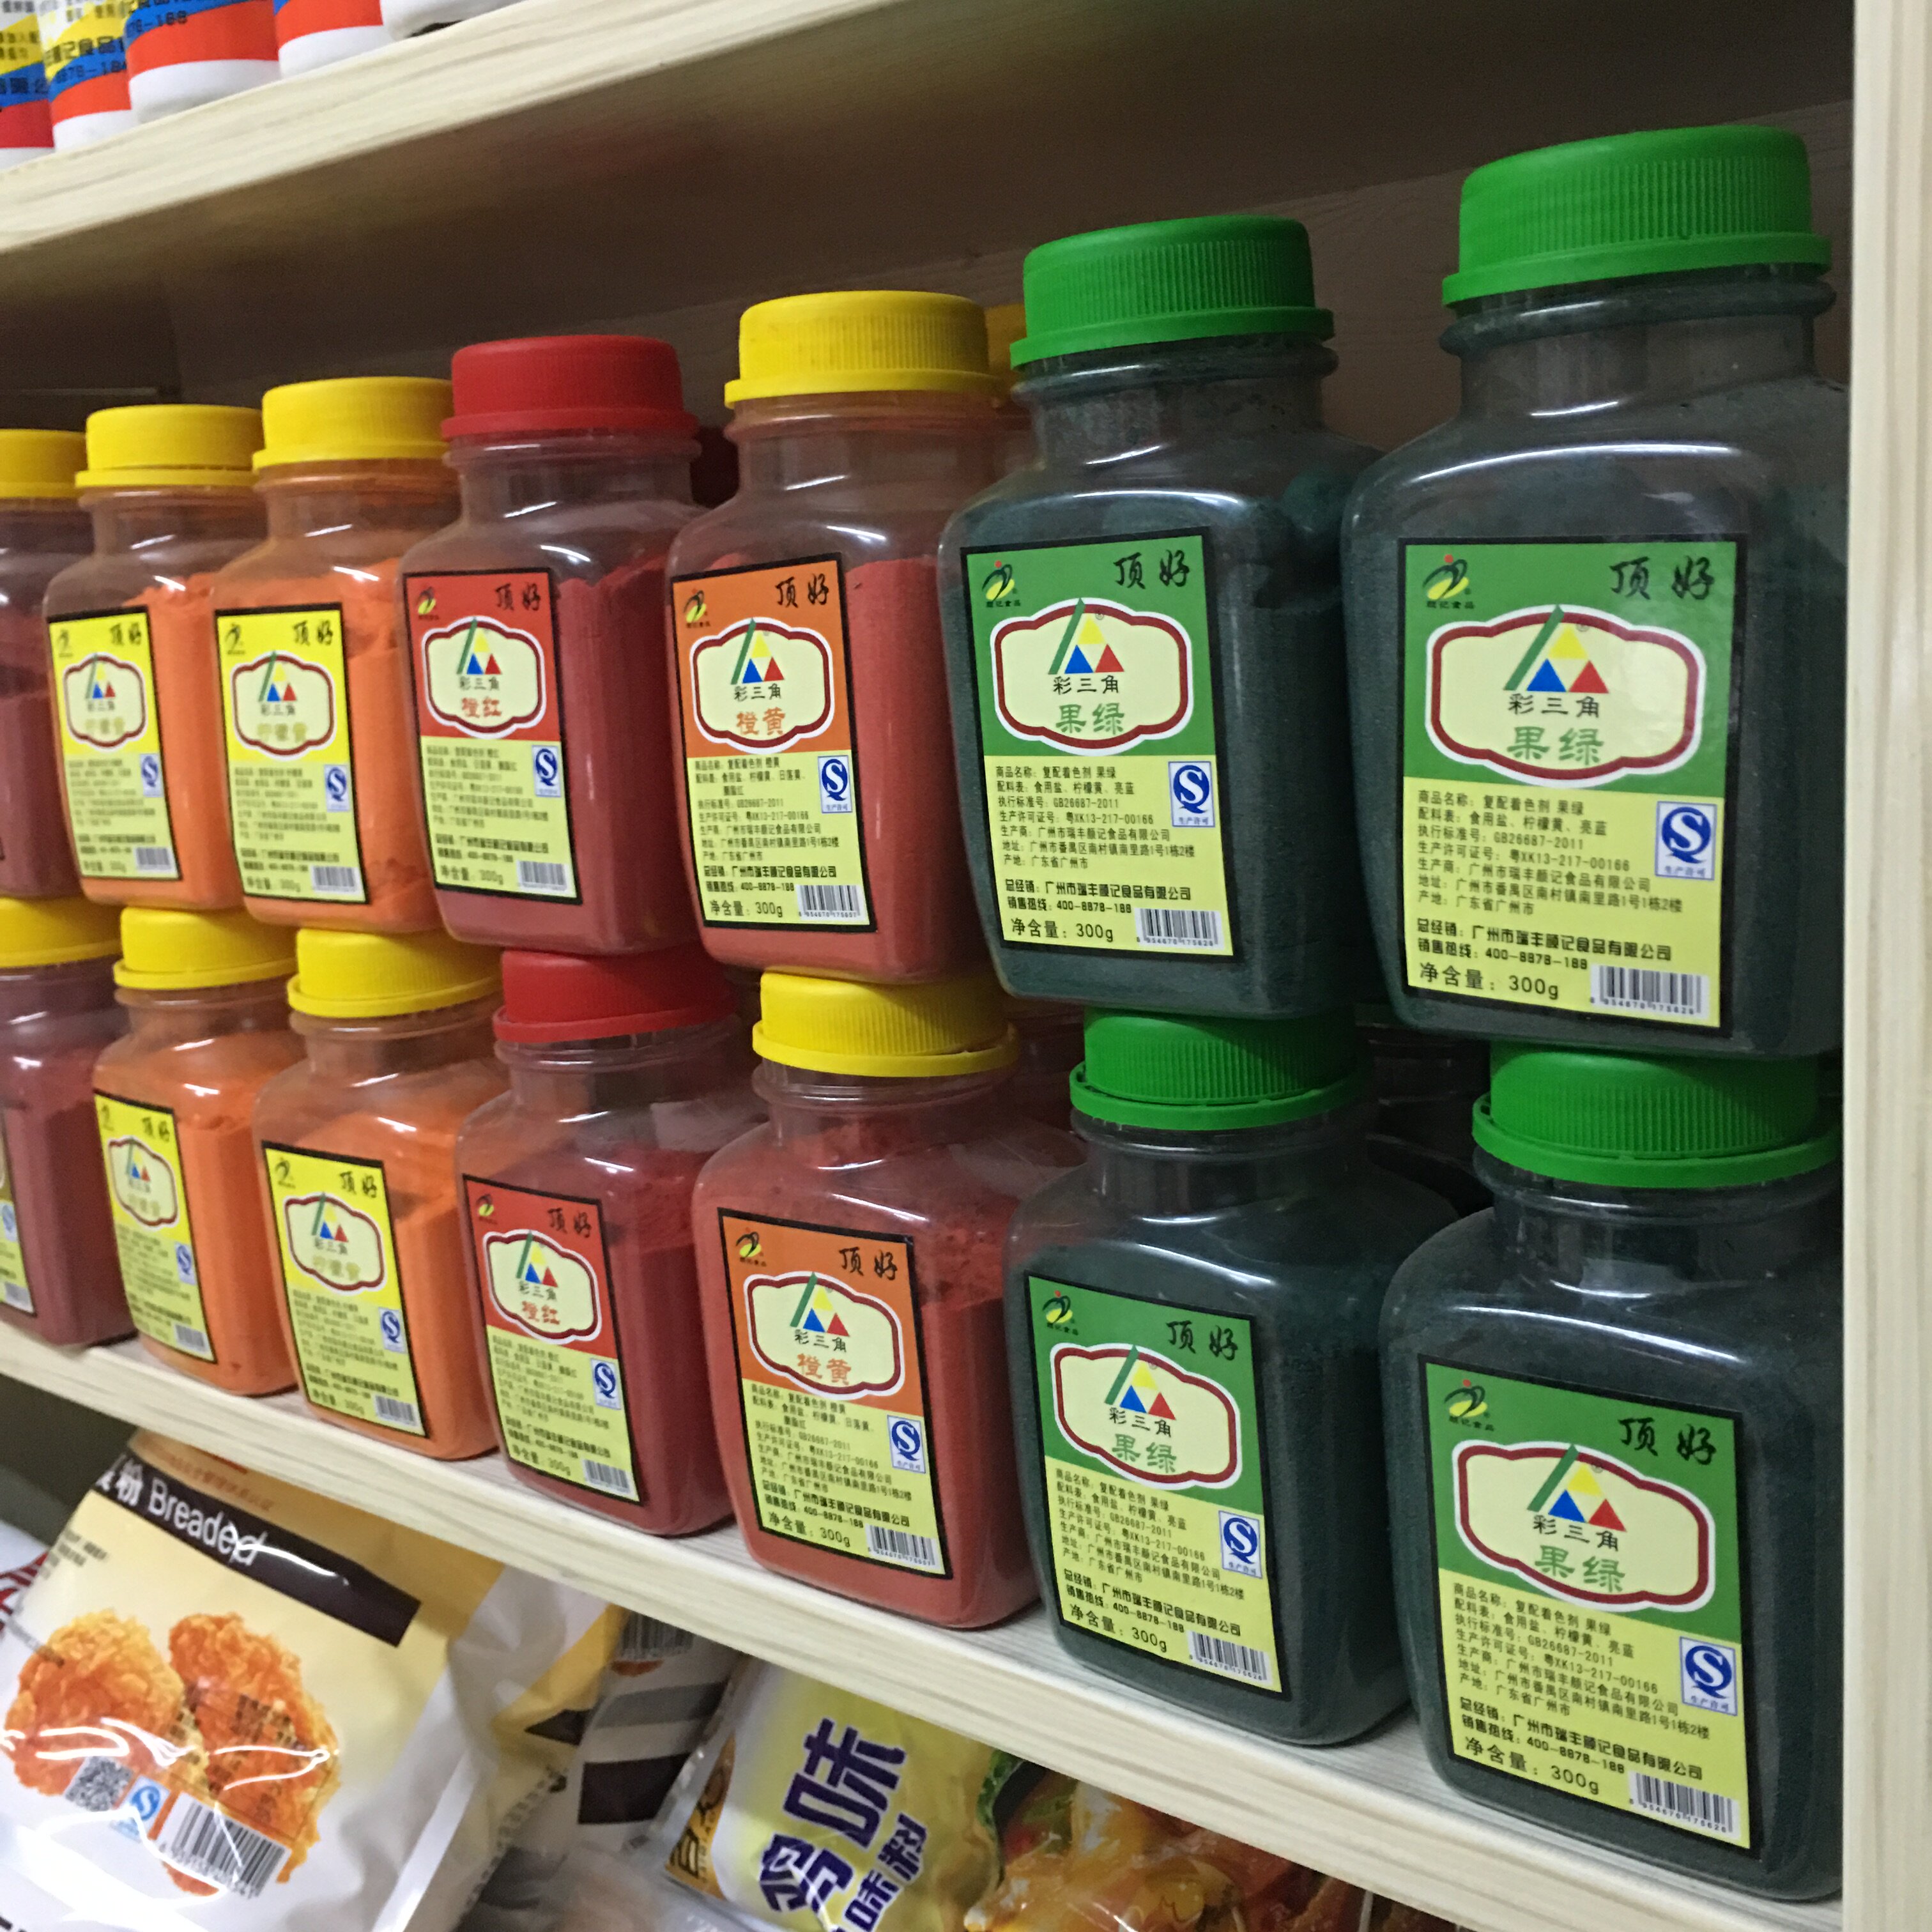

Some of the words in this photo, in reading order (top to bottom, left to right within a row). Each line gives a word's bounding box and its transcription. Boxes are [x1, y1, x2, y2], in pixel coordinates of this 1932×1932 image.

[1114, 550, 1190, 589] 顶好
[1608, 556, 1715, 600] 顶好
[775, 574, 829, 608] 顶好
[733, 682, 781, 702] 彩三角
[1052, 674, 1119, 694] 彩三角
[735, 707, 786, 737] 橙黄
[1053, 702, 1126, 734] 果绿
[1507, 693, 1600, 717] 彩三角
[1506, 724, 1604, 765] 果绿
[839, 1246, 898, 1280] 顶好
[793, 1328, 847, 1353] 彩三角
[1167, 1320, 1238, 1361] 顶好
[797, 1353, 852, 1385] 橙黄
[1107, 1406, 1172, 1438] 彩三角
[1111, 1434, 1177, 1473] 果绿
[1619, 1417, 1716, 1464] 顶好
[148, 1476, 268, 1567] Breaded
[1531, 1513, 1619, 1552] 彩三角
[1535, 1545, 1625, 1593] 果绿
